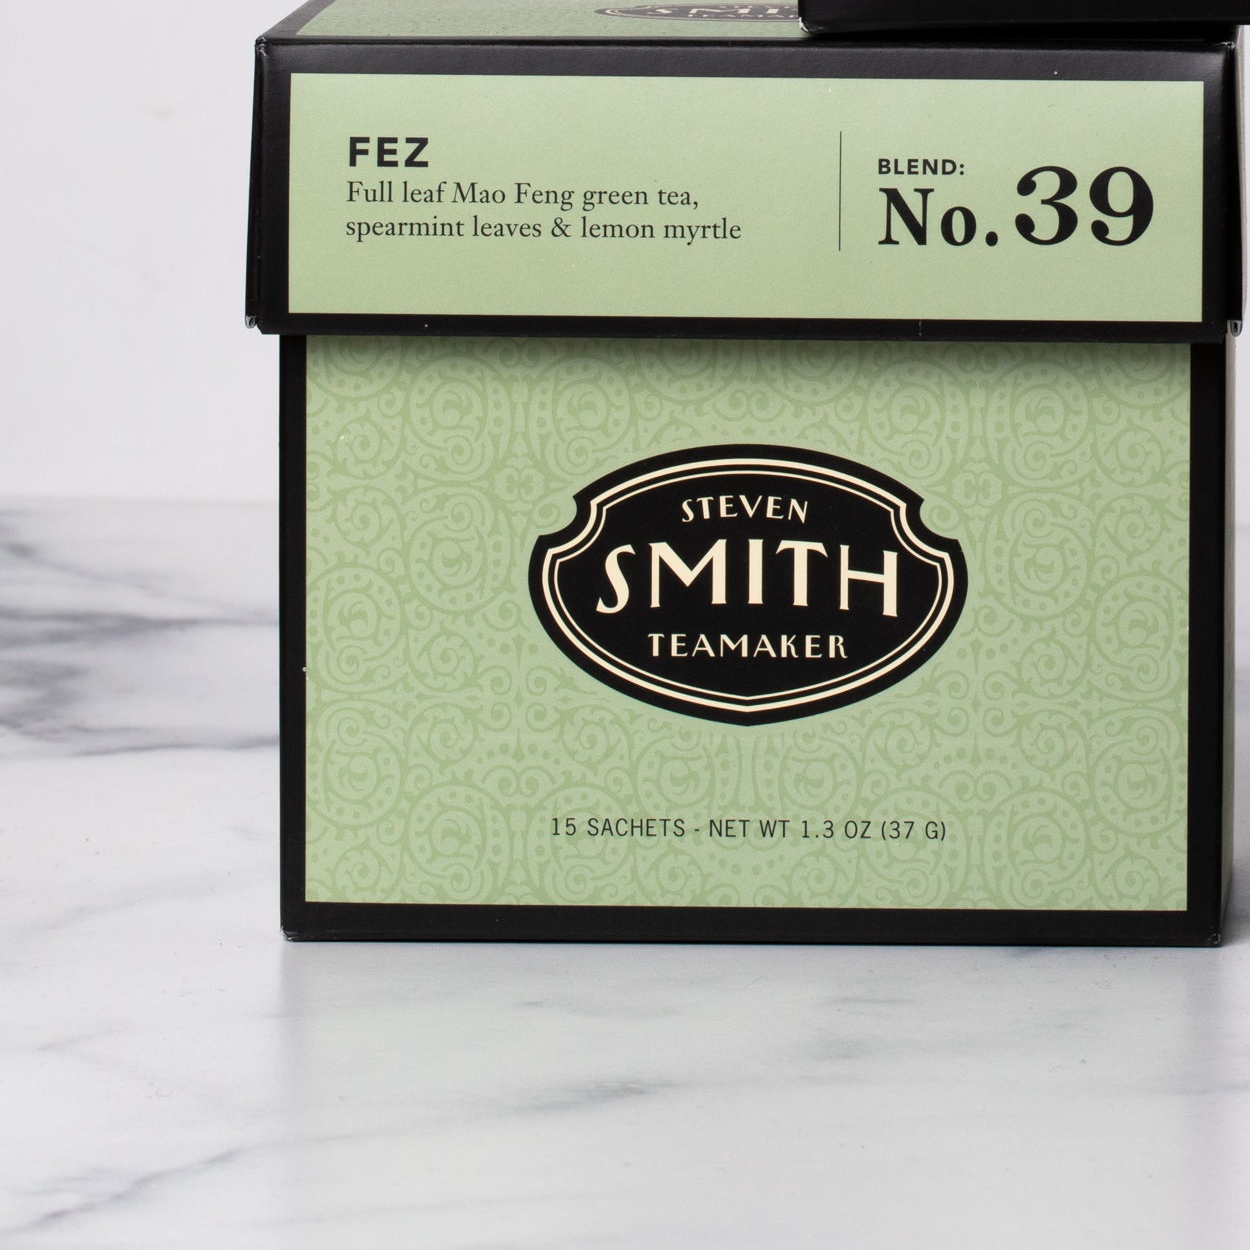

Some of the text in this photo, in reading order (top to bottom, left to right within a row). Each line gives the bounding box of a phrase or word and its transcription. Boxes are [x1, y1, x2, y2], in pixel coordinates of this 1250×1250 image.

[349, 136, 429, 168] FEZ
[878, 158, 965, 176] BLEND:
[346, 180, 699, 212] Full leaf Mao Feng green tea,
[346, 214, 741, 246] spearmint leaves & lemon myrtle
[681, 494, 808, 524] STEVEN
[595, 538, 898, 618] SMITH
[647, 633, 848, 659] TEAMAKER
[552, 817, 577, 837] 15
[586, 817, 685, 838] SACHETS
[709, 819, 751, 838] NET
[759, 819, 791, 838] WT
[801, 819, 835, 839] 1.3
[844, 820, 872, 839] OZ
[881, 820, 915, 841] (37
[924, 820, 946, 842] G)
